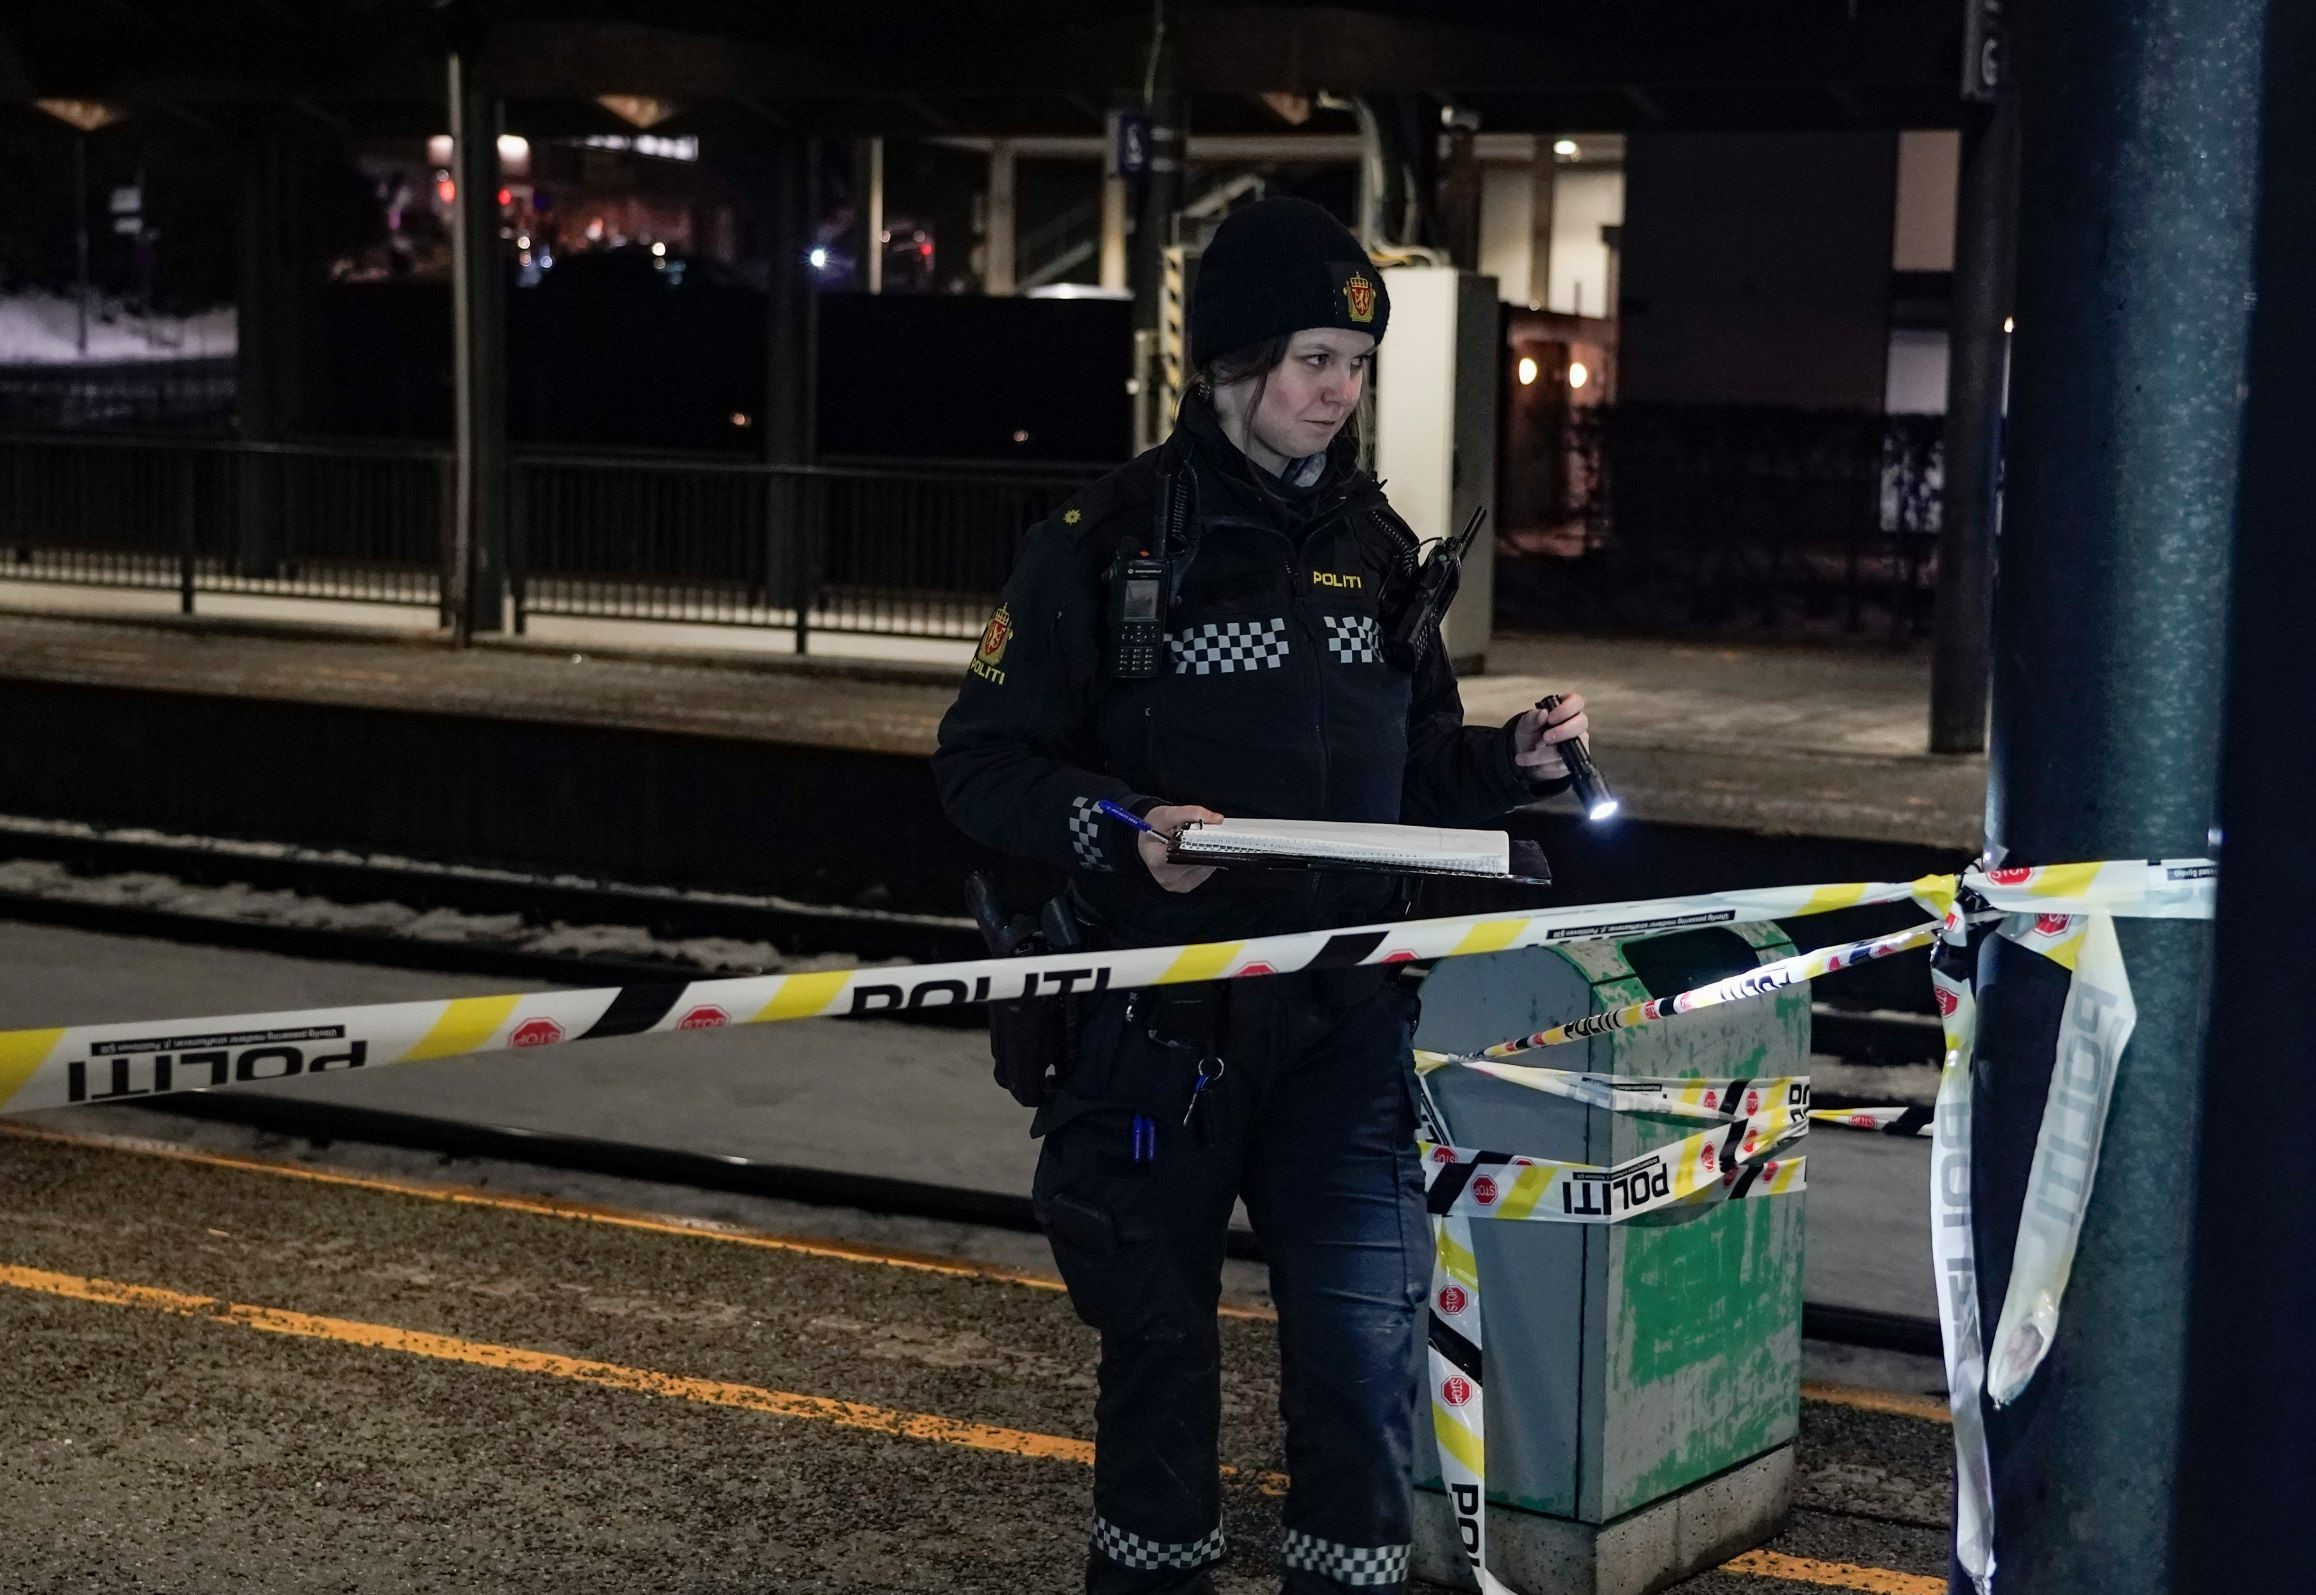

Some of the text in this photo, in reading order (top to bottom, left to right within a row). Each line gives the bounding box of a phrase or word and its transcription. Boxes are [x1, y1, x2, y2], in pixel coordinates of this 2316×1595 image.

[1313, 570, 1362, 589] POLITI
[971, 657, 1005, 685] POLITI
[1475, 1184, 1495, 1197] STOP
[1563, 1163, 1670, 1216] POLITI
[1446, 1288, 1458, 1312] STOP
[1450, 1378, 1463, 1405] STOP
